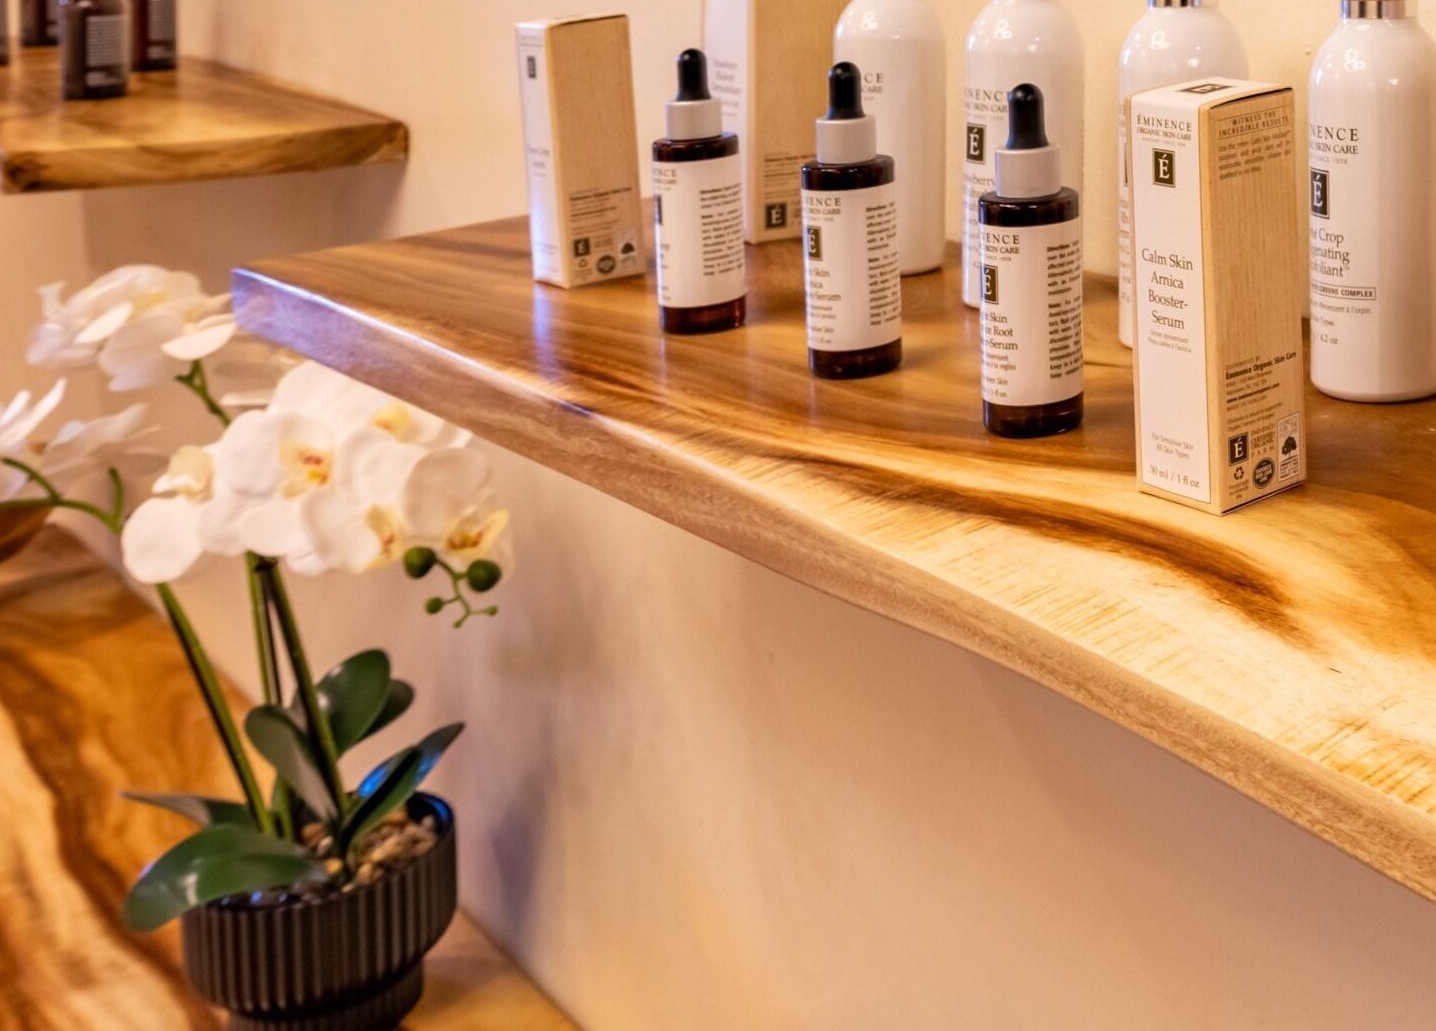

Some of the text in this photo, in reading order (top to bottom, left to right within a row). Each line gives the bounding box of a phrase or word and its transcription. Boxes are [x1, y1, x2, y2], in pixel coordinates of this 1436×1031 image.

[1333, 144, 1360, 154] CARE
[1158, 154, 1170, 179] É
[1318, 228, 1344, 248] Crop
[1141, 248, 1193, 271] Calm Skin
[1151, 270, 1184, 289] Arnica
[1148, 290, 1188, 309] Booster-
[1341, 288, 1373, 298] COMPLEX
[989, 312, 1008, 324] Skin
[1152, 310, 1184, 330] Serum
[993, 325, 1014, 338] Root
